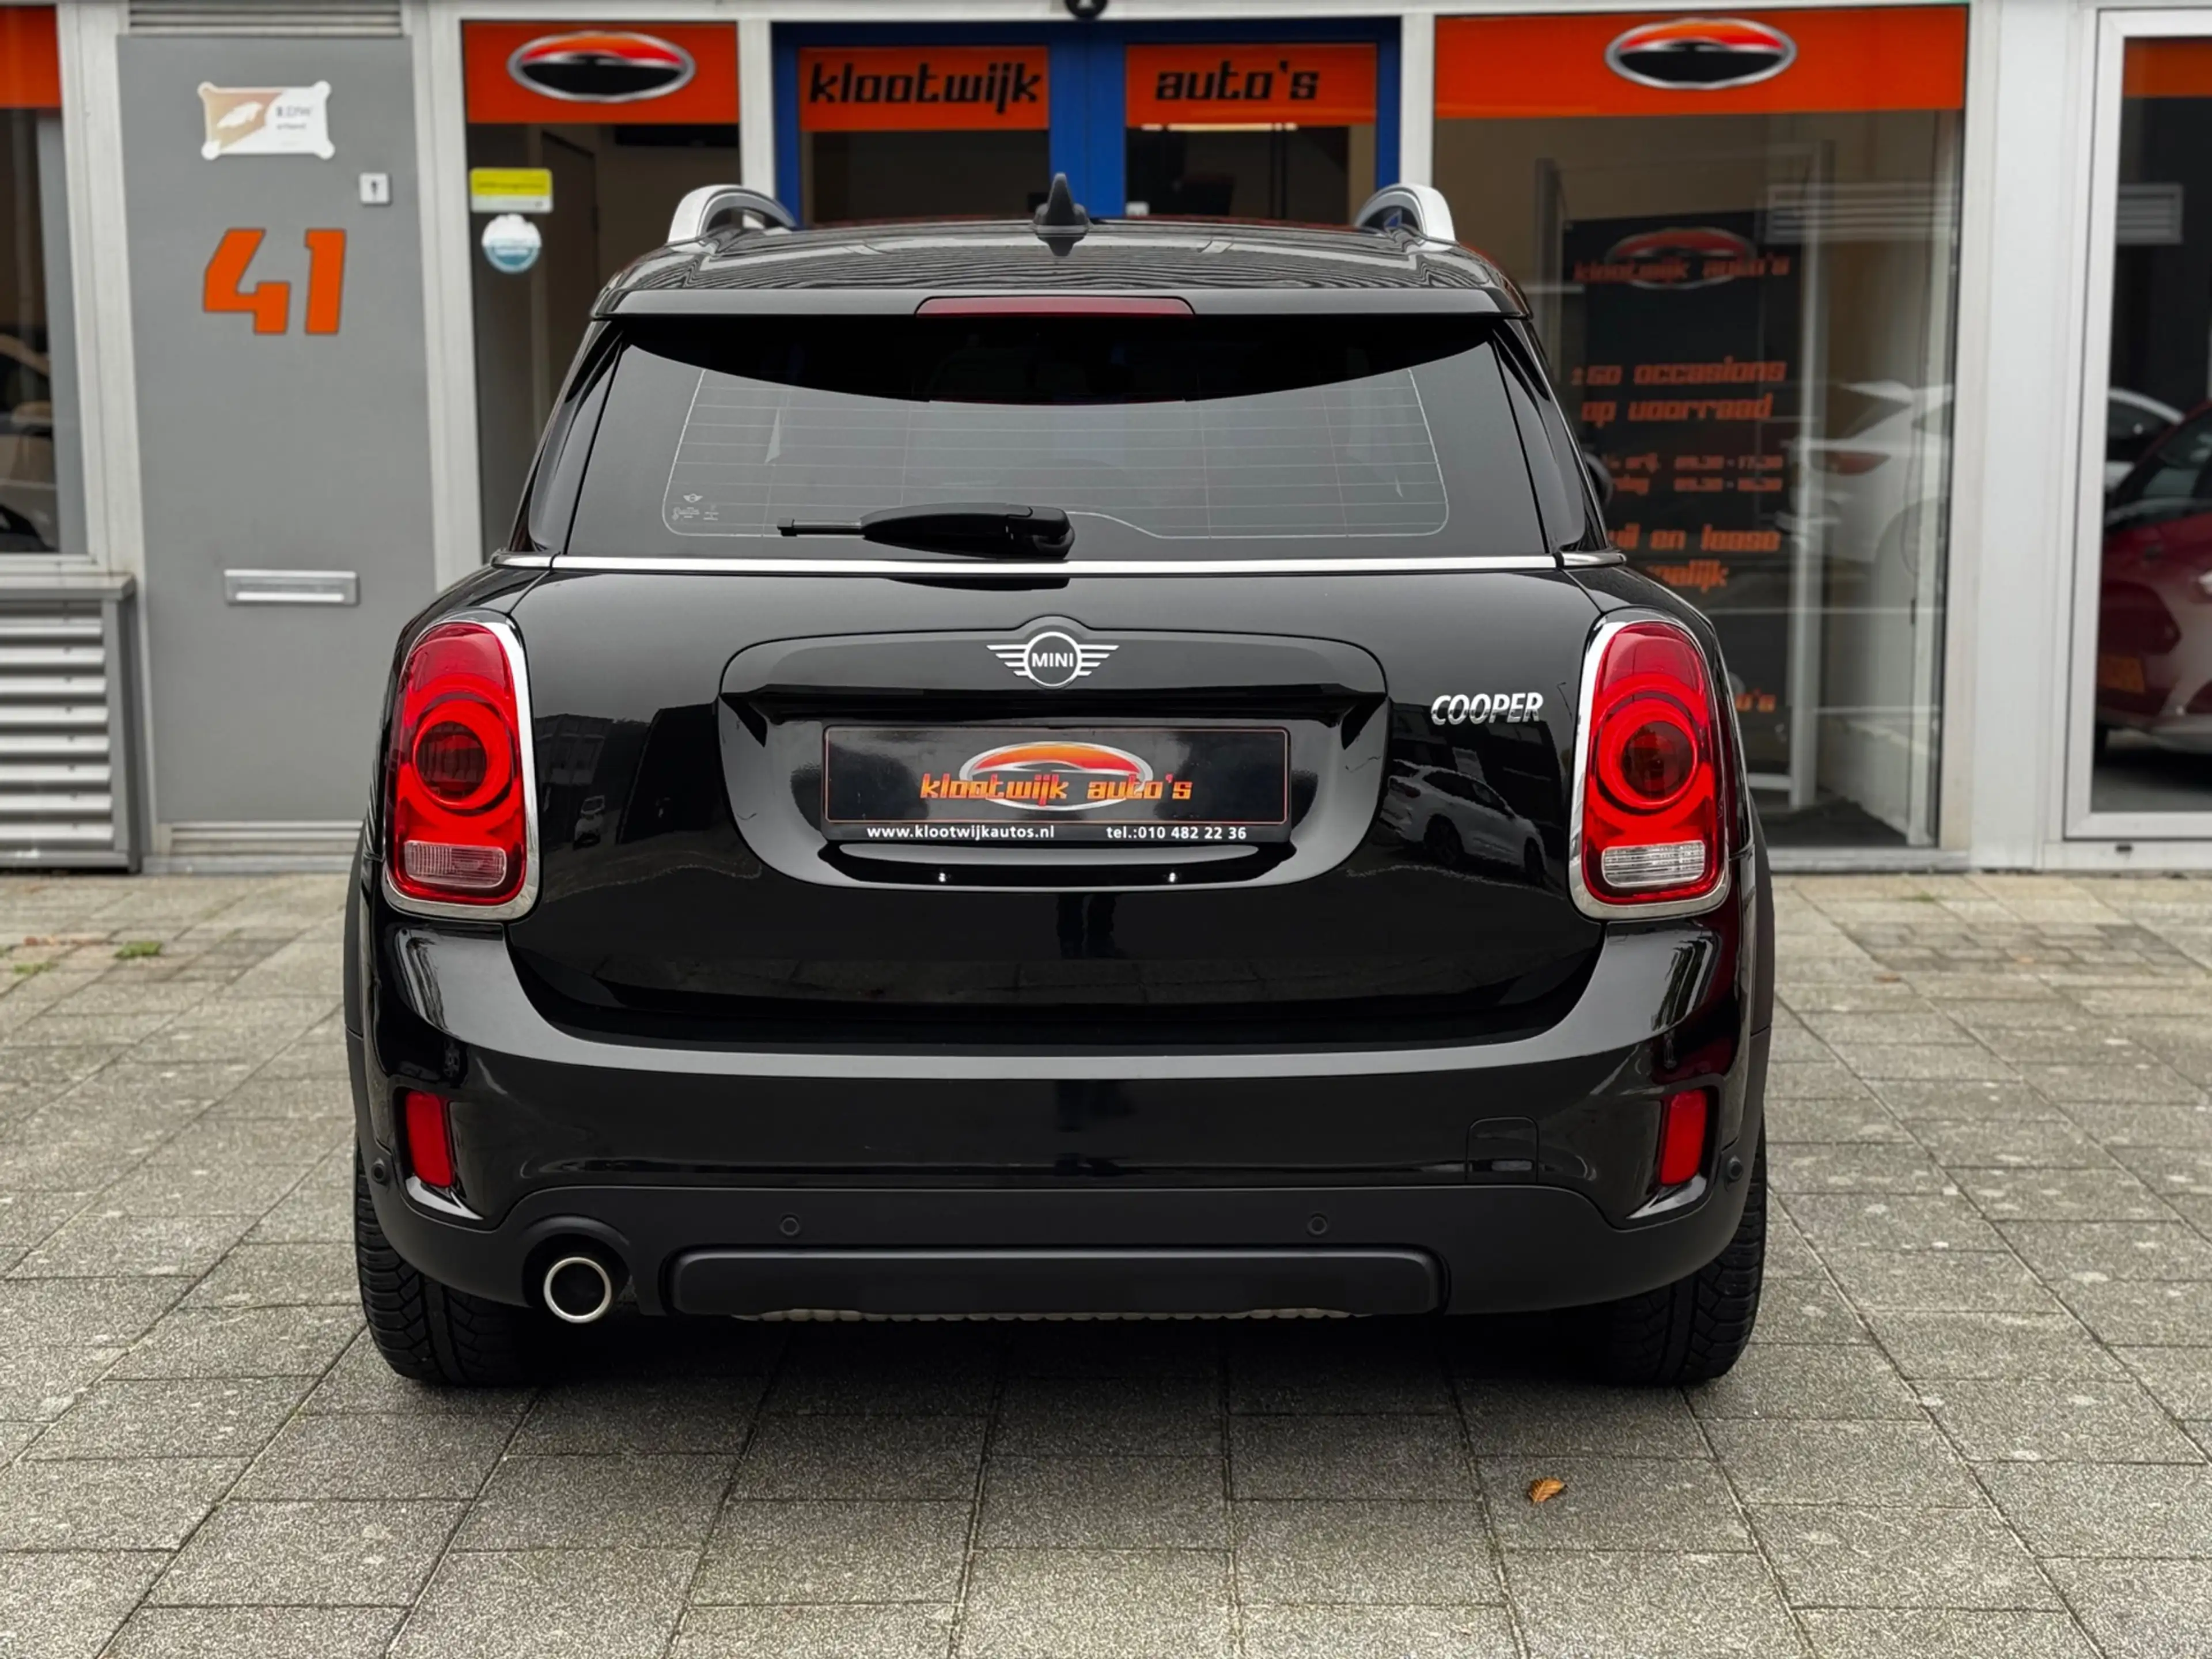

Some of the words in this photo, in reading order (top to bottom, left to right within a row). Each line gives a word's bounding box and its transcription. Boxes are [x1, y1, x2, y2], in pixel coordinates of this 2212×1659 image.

[809, 62, 1041, 113] klootwijk
[1156, 60, 1319, 101] auto's
[203, 228, 346, 335] 41
[1634, 356, 1786, 385] occasions
[1581, 401, 1616, 428] op
[1032, 652, 1074, 668] MINI
[1430, 692, 1544, 725] COOPER
[920, 774, 1068, 806] klootwijk
[1087, 774, 1192, 800] auto's
[866, 824, 1054, 841] www.klootwijkautos.nl
[1171, 826, 1199, 839] 482
[1204, 827, 1223, 840] 22
[1228, 827, 1247, 840] 36
